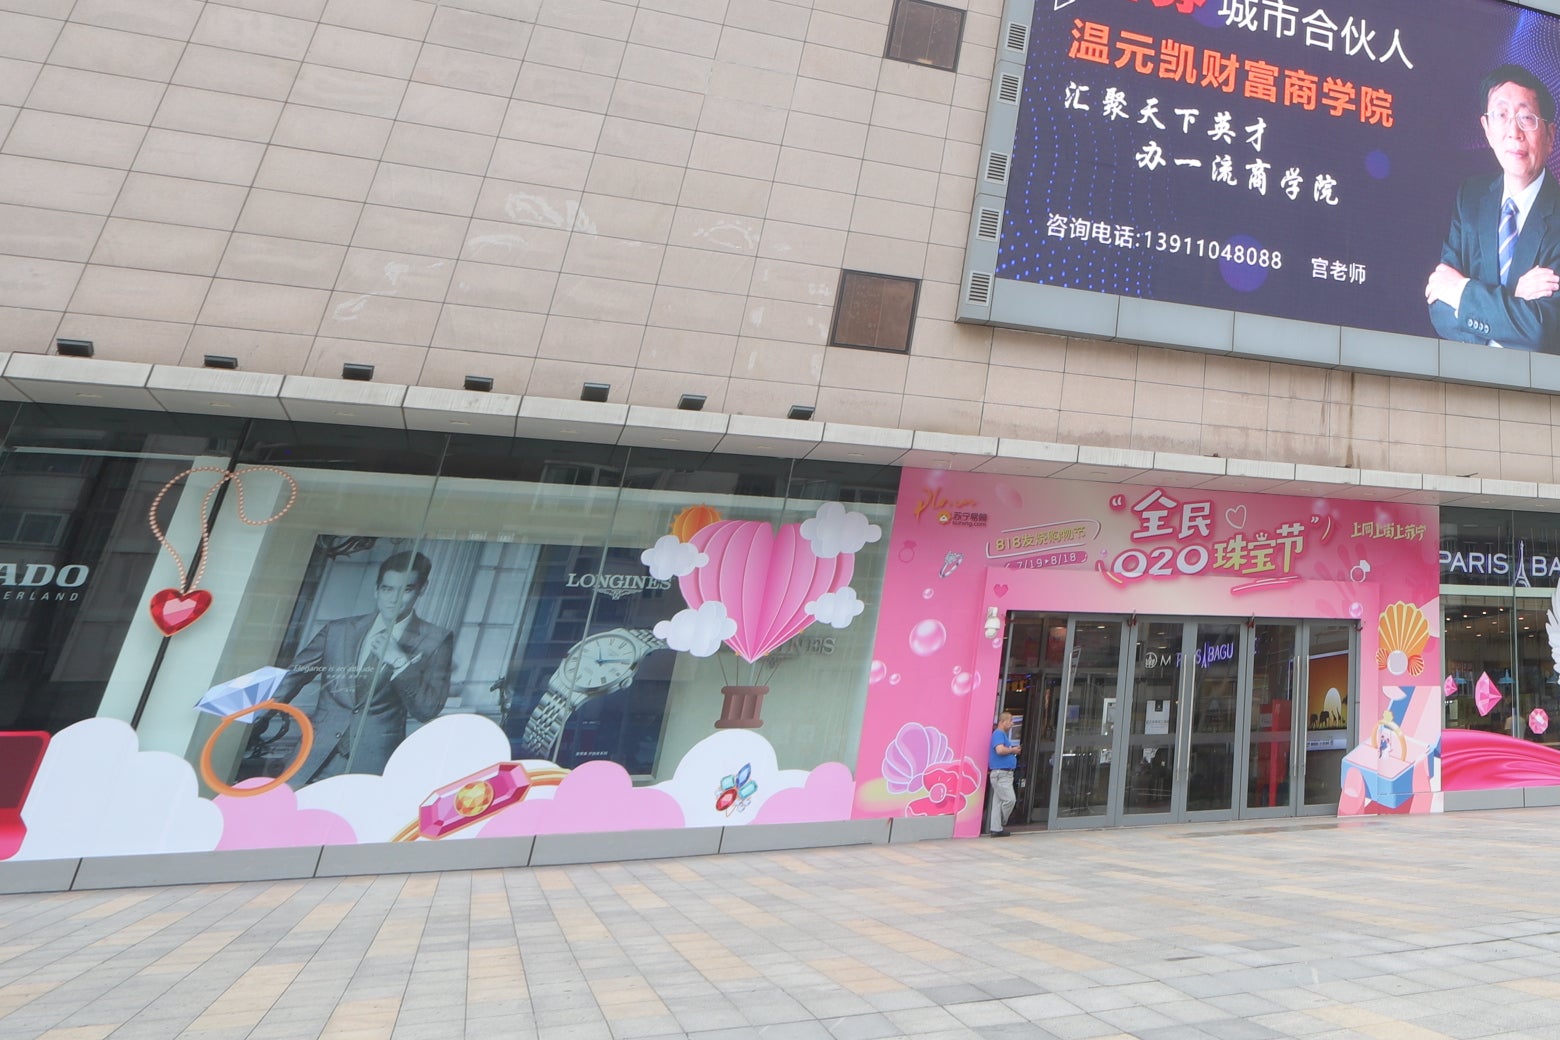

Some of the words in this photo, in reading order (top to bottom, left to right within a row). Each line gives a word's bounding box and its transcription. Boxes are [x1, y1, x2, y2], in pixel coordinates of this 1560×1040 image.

[1068, 18, 1395, 128] 温元凯财富商学院
[1064, 81, 1268, 152] 汇聚天下英才
[1135, 141, 1339, 206] 办一流商学院
[1311, 257, 1366, 285] 宫老师
[995, 526, 1086, 551] 818发烧购物节
[1351, 522, 1427, 542] 上网上街上苏宁
[1439, 550, 1509, 575] PARIS
[566, 573, 672, 590] LONGINES
[293, 665, 326, 673] Elegance
